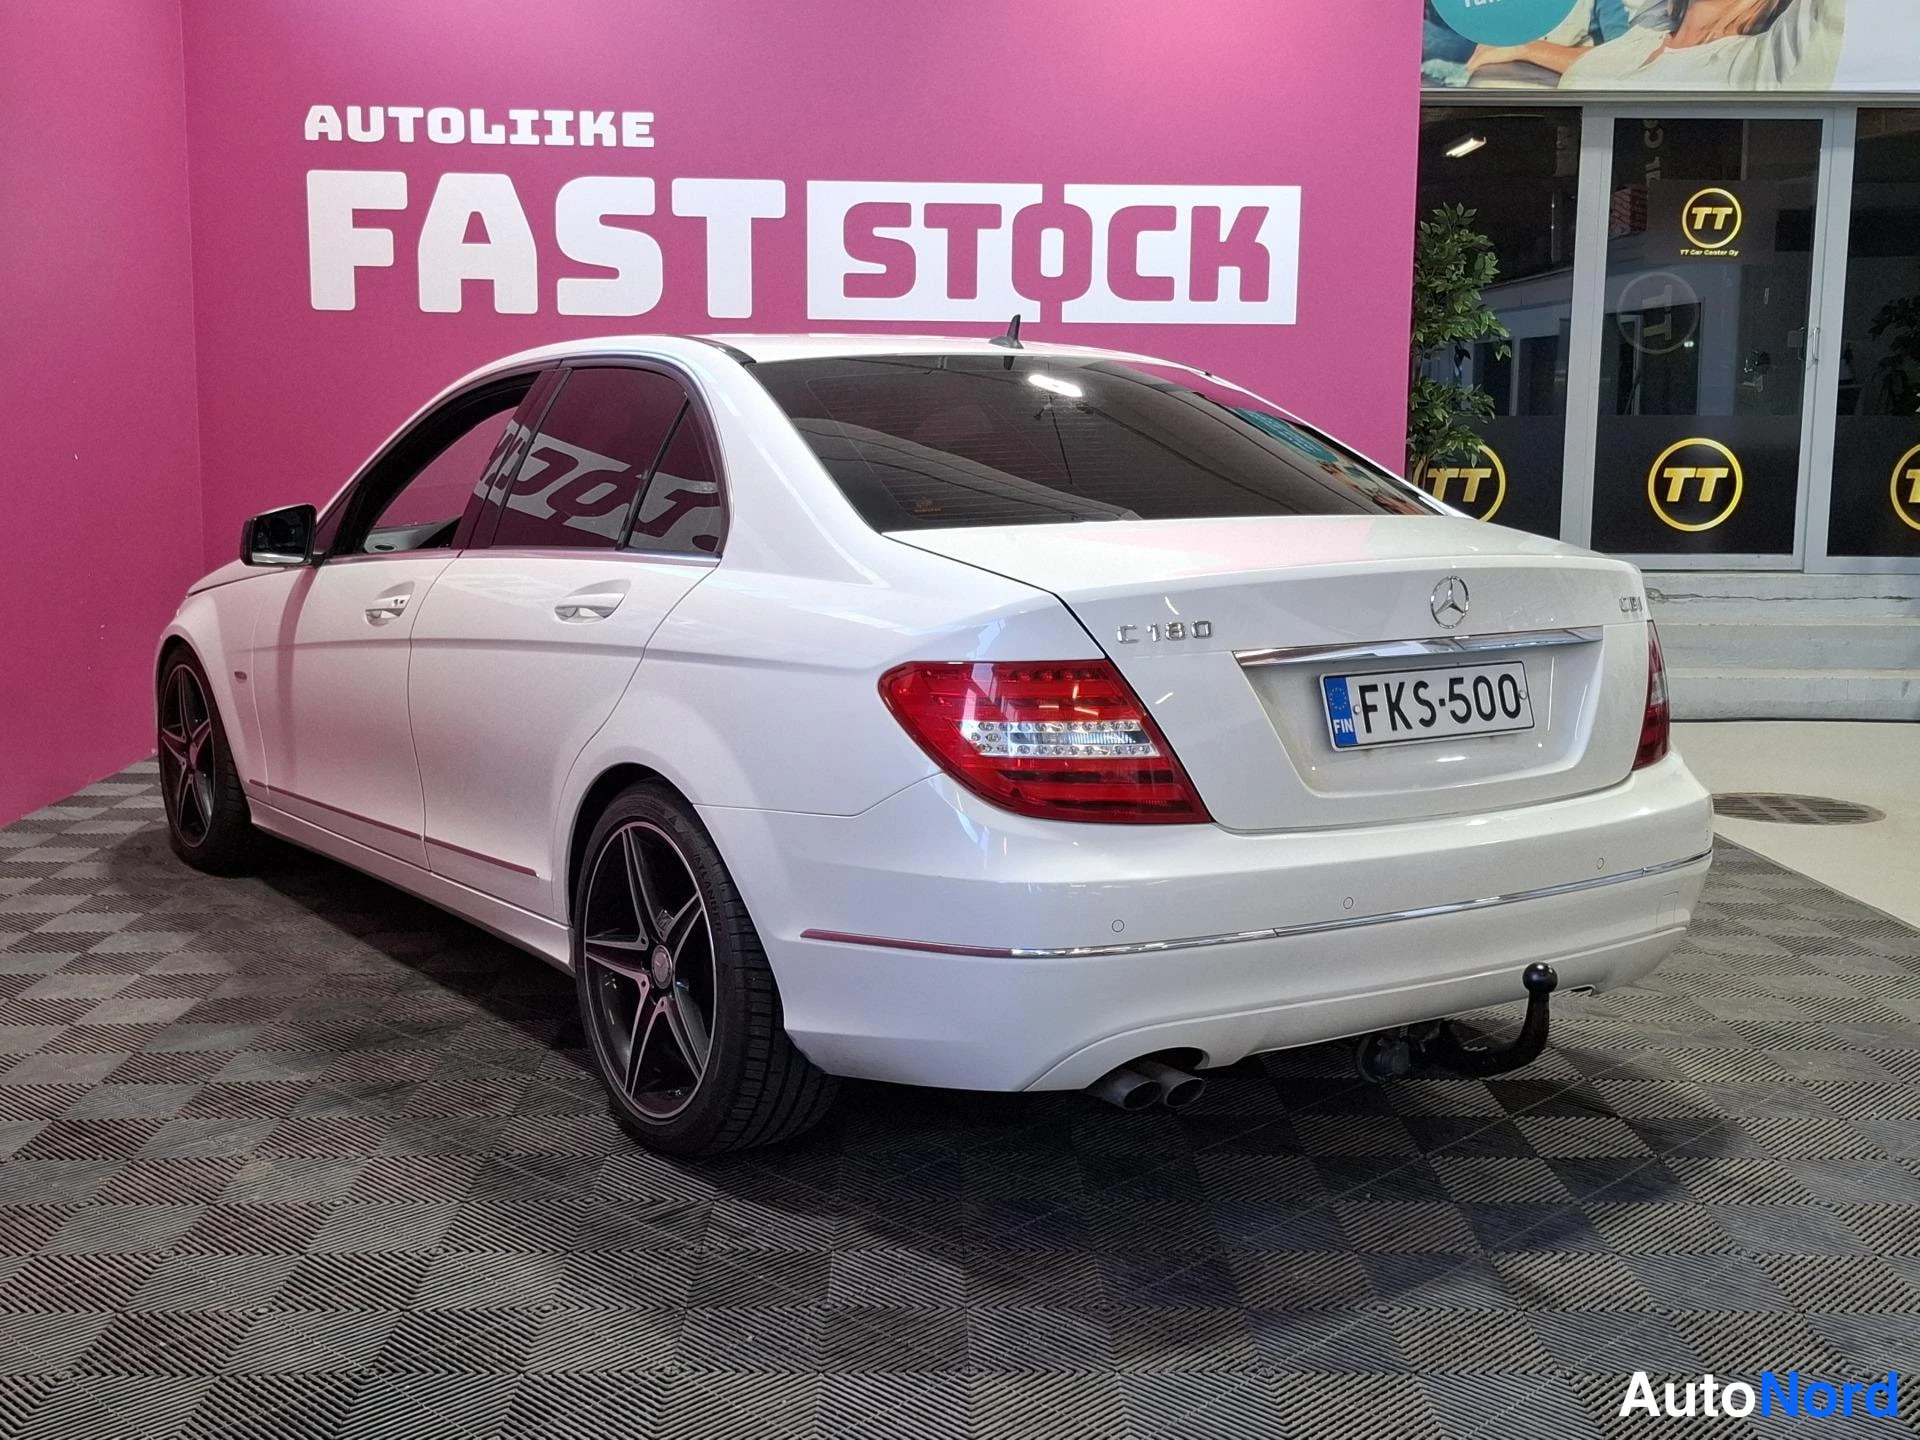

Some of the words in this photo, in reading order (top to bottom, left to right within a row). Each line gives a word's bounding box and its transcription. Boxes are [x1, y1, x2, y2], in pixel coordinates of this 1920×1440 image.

[304, 104, 656, 149] AUTOLIIKE
[1691, 207, 1734, 230] TT
[306, 169, 787, 319] FAST
[842, 190, 1271, 322] STOCK
[1728, 249, 1740, 257] Oy
[1427, 467, 1492, 502] TT
[1662, 466, 1728, 502] TT
[1358, 673, 1522, 734] FKS-500
[1332, 718, 1354, 734] FIN
